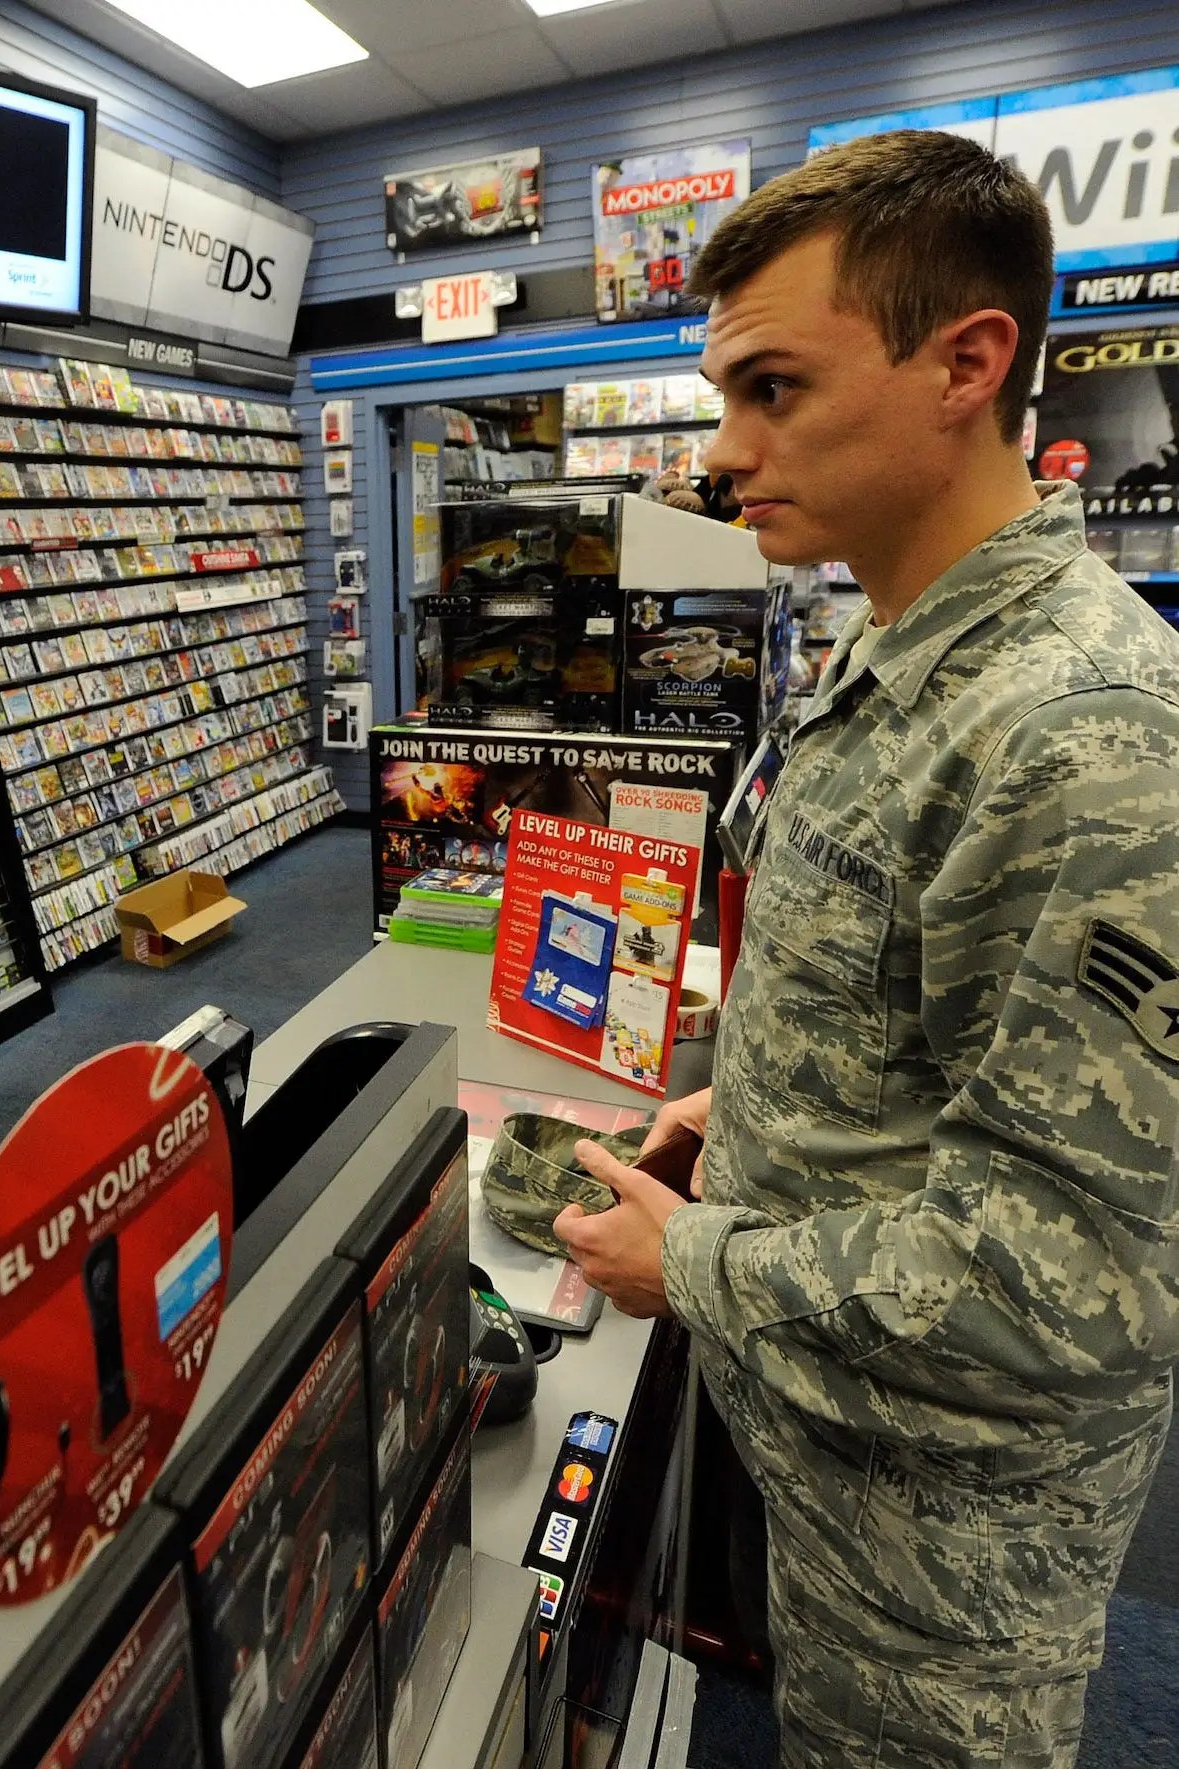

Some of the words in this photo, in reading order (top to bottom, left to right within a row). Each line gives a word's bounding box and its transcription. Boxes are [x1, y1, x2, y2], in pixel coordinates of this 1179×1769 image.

[606, 172, 732, 213] MONOPOLY
[104, 196, 228, 263] NINTENDO
[221, 244, 276, 301] DS
[8, 269, 37, 285] Sprint
[1075, 274, 1145, 306] NEW
[436, 277, 483, 321] EXIT
[128, 338, 156, 361] NEW
[156, 344, 194, 368] GAMES
[428, 596, 471, 605] HALO
[656, 682, 722, 692] SCORPION
[431, 706, 473, 716] HALO
[634, 710, 743, 729] HALO
[380, 739, 423, 759] JOIN
[427, 740, 470, 761] THE
[473, 744, 546, 765] QUEST
[550, 747, 580, 767] TO
[583, 749, 643, 772] SAVE
[648, 752, 716, 778] ROCK
[616, 787, 638, 795] OVER
[653, 789, 703, 802] SHREDDING
[616, 794, 653, 809] ROCK
[656, 798, 702, 814] SONGS
[516, 840, 538, 854] ADD
[538, 845, 559, 858] ANY
[559, 850, 573, 861] OF
[573, 853, 600, 869] THESE
[601, 859, 615, 872] TO
[519, 813, 561, 839] LEVEL
[564, 823, 586, 843] UP
[589, 828, 635, 855] THEIR
[638, 840, 688, 868] GIFTS
[516, 854, 542, 867] MAKE
[542, 859, 559, 872] THE
[559, 863, 580, 877] GIFT
[580, 867, 612, 885] BETTER
[644, 896, 678, 911] ADD-ONS
[37, 1205, 77, 1261] UP
[78, 1144, 151, 1225] YOUR
[155, 1091, 210, 1160] GIFTS
[232, 1408, 295, 1509] COMING
[546, 1517, 572, 1553] VISA
